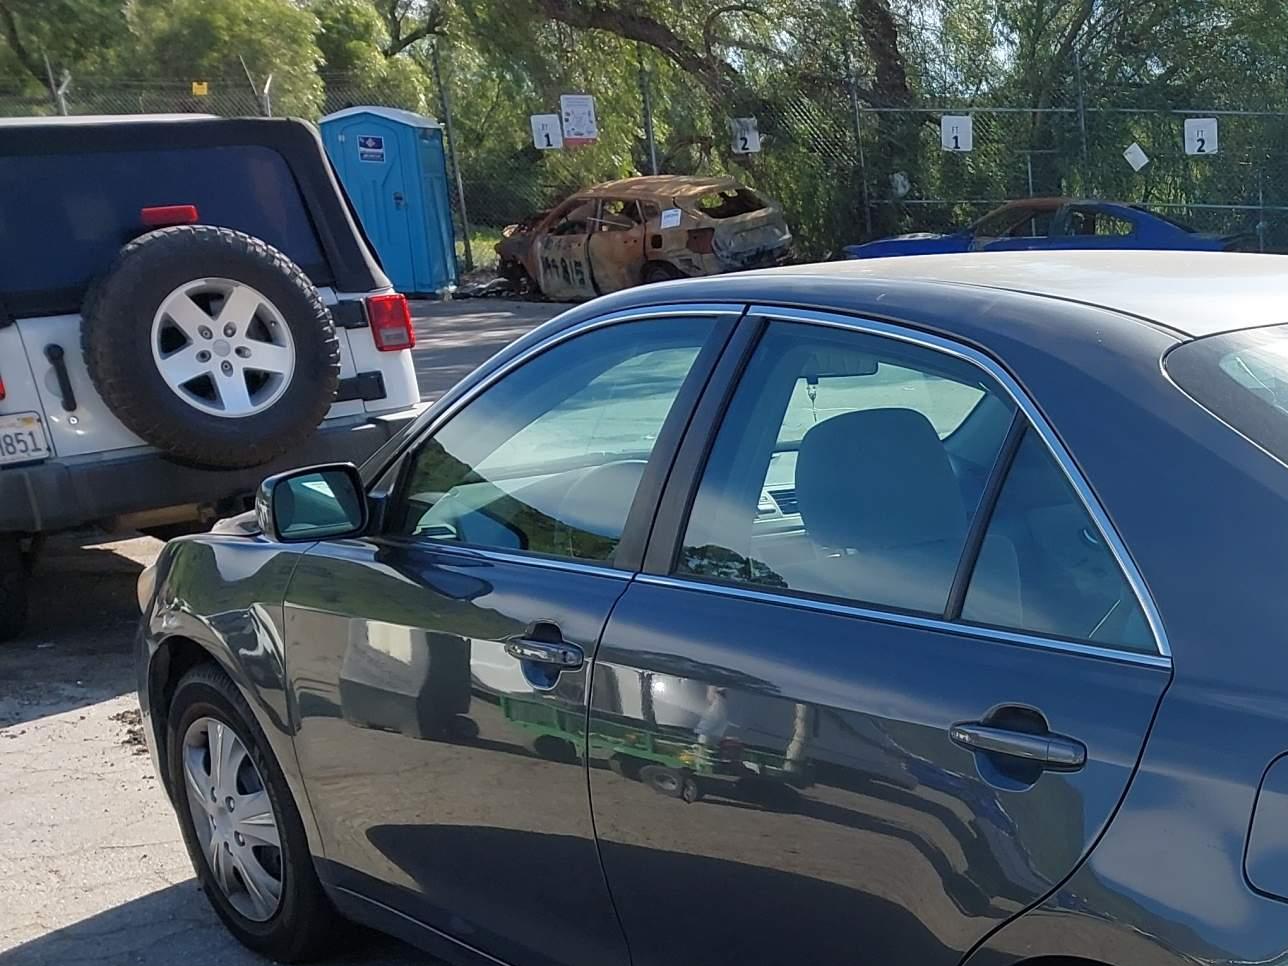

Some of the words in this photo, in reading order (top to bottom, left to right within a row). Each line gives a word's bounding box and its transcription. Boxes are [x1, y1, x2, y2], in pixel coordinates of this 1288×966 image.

[544, 133, 553, 147] 1
[740, 137, 750, 150] 2
[952, 135, 961, 149] 1
[1196, 138, 1206, 152] 2
